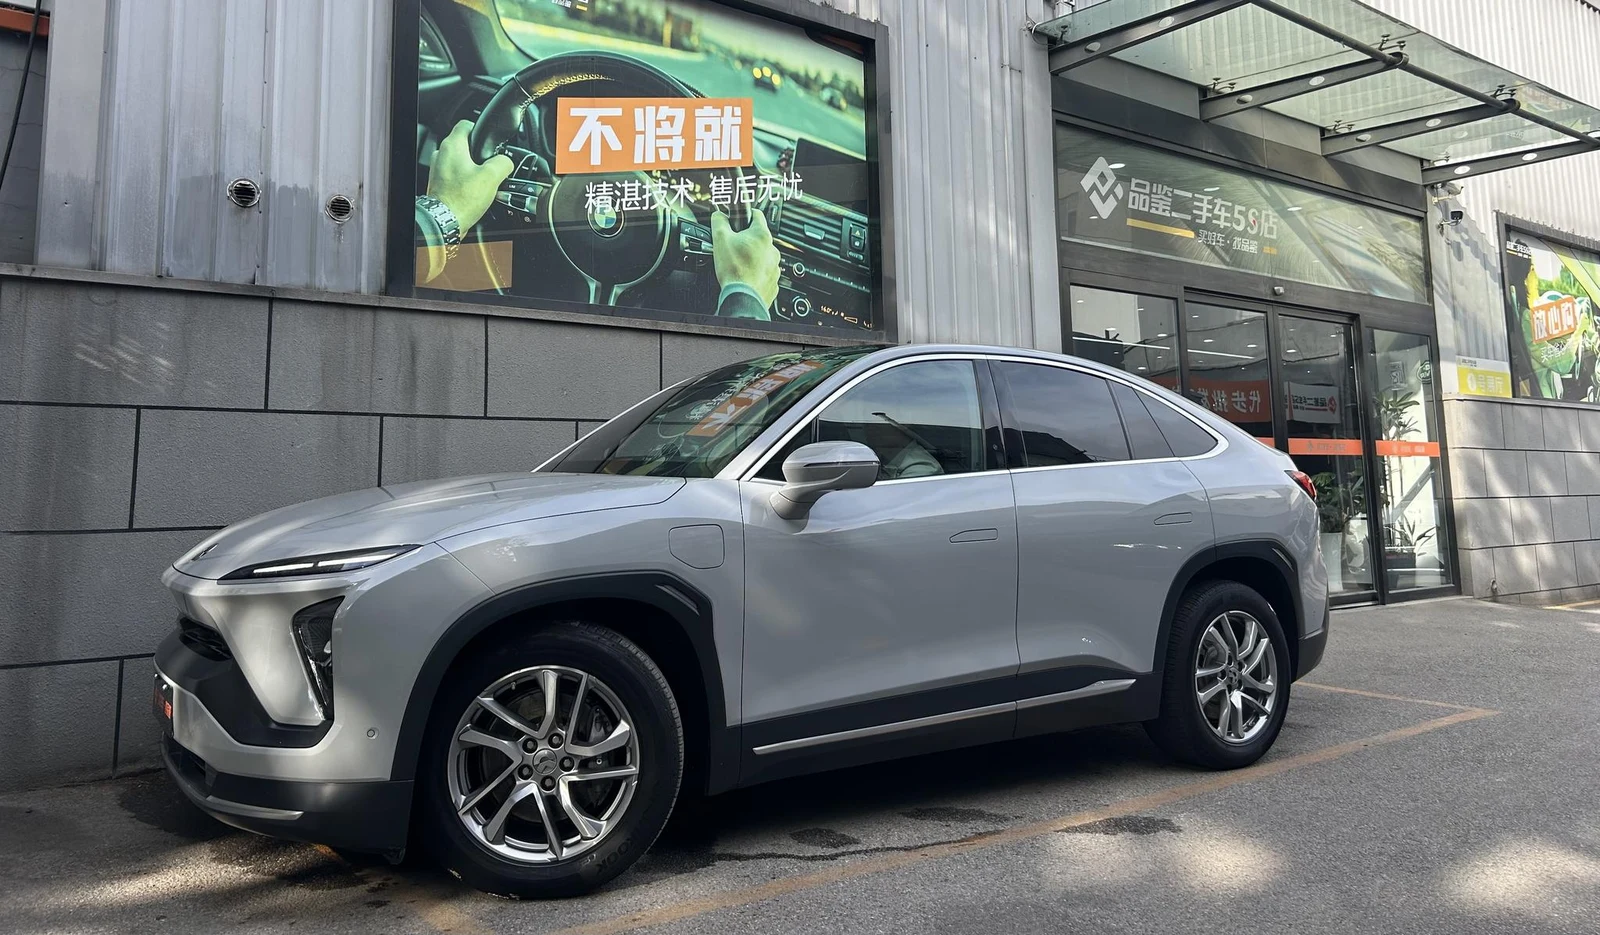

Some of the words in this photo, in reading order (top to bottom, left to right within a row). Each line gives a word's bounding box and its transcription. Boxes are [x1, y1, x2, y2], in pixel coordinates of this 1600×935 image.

[569, 105, 742, 166] 不将就
[584, 177, 694, 215] 精湛技术
[709, 172, 803, 206] 售后无忧
[1128, 177, 1278, 240] 品鉴二手车5S店
